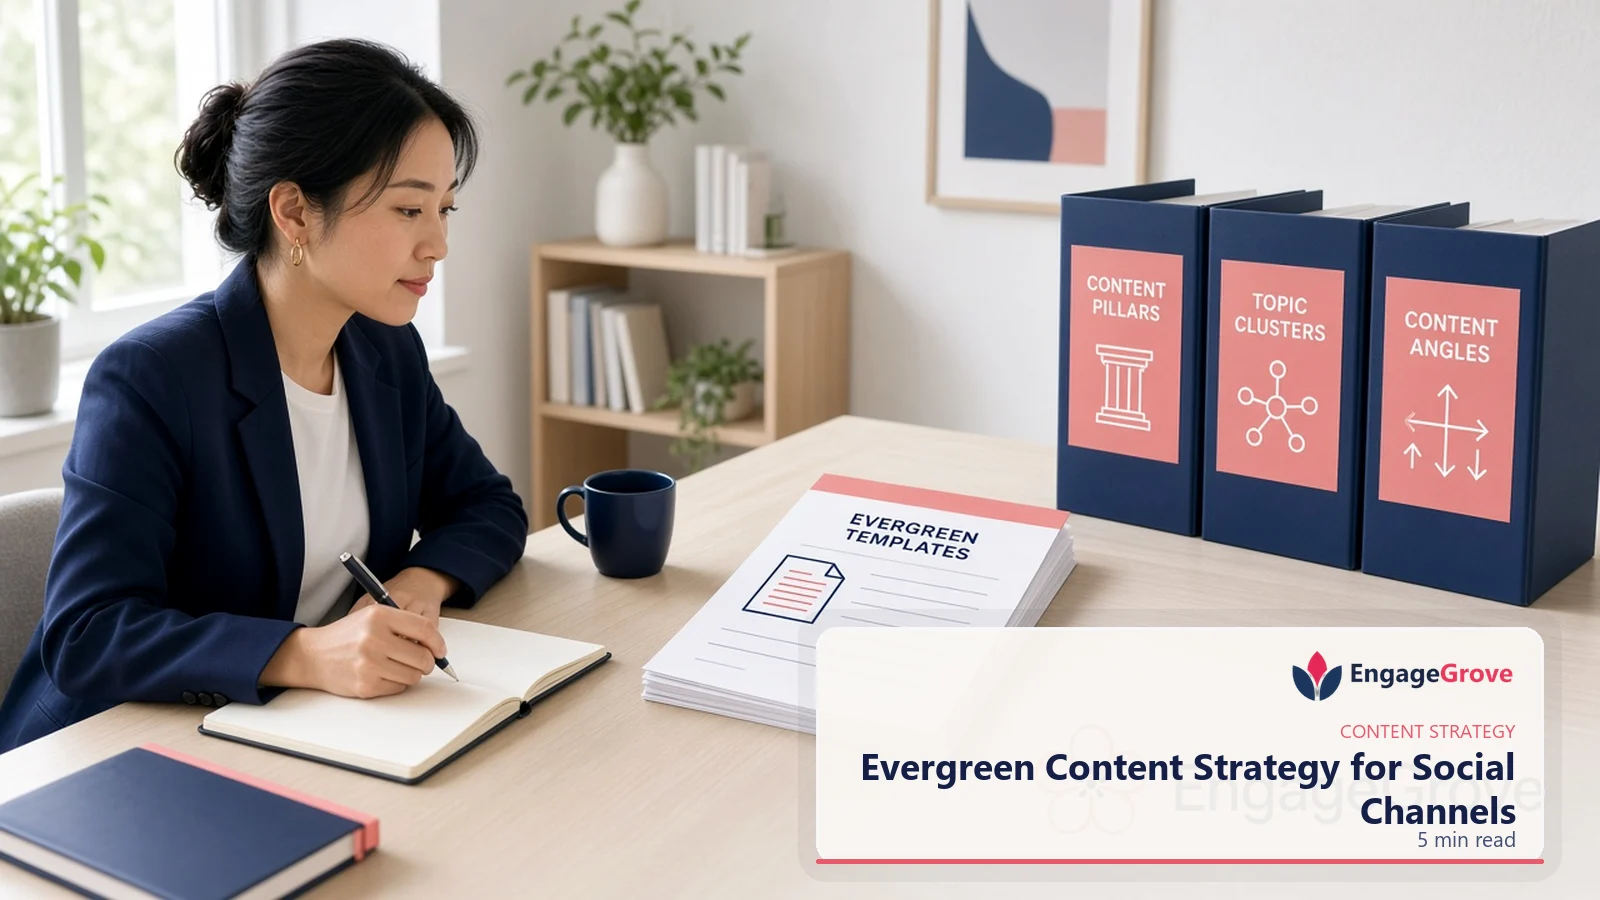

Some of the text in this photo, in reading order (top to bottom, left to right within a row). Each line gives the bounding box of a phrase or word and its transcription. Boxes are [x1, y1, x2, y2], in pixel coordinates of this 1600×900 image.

[1086, 275, 1166, 299] CONTENT
[1092, 298, 1160, 322] PILLARS
[1252, 292, 1308, 315] TOPIC
[1234, 315, 1326, 342] CLUSTERS
[1404, 310, 1499, 337] CONTENT
[1409, 338, 1490, 363] ANGLES
[849, 512, 980, 545] EVERGREEN
[845, 528, 971, 561] TEMPLATES
